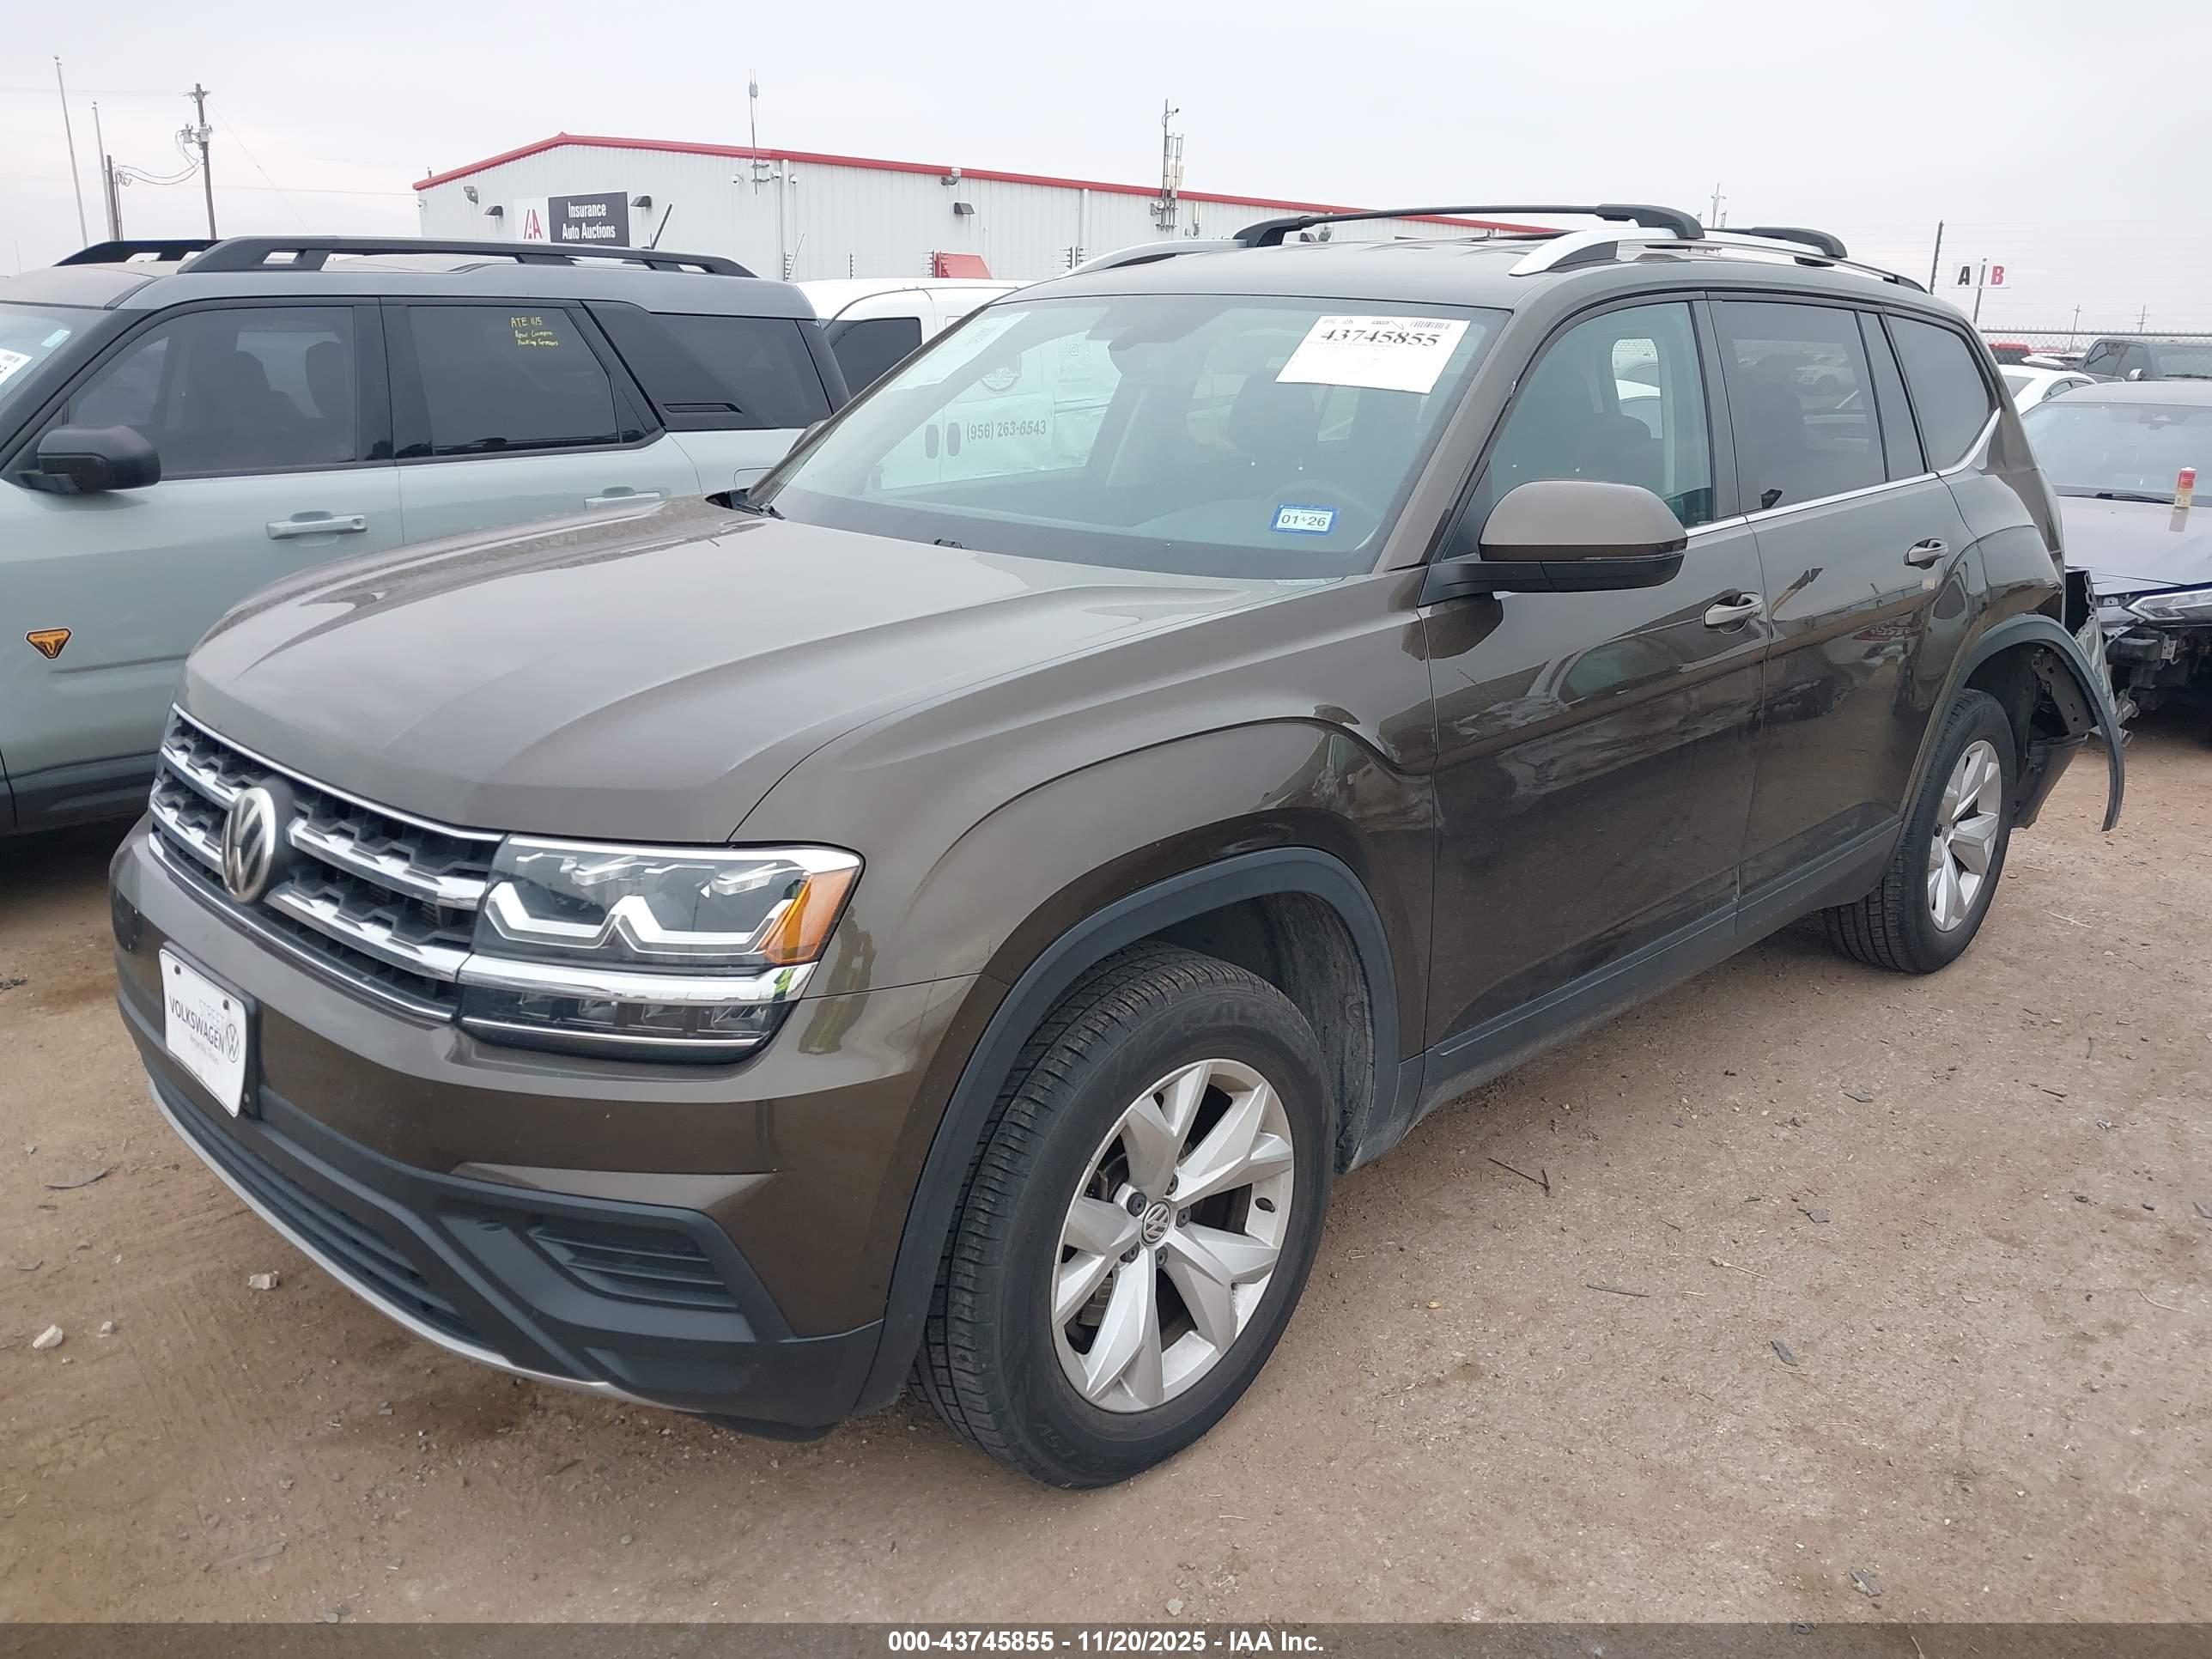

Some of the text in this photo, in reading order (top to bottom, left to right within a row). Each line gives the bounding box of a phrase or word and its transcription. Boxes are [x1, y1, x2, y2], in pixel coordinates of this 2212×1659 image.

[568, 201, 607, 218] Insurance
[562, 222, 617, 240] Auto Auctions
[1958, 265, 1971, 286] A
[1990, 265, 2005, 286] B
[1321, 329, 1443, 347] 43745855
[967, 419, 1047, 443] (956) 263-6543
[1281, 514, 1327, 527] 01 26
[168, 995, 225, 1055] VOLKSWAGEN
